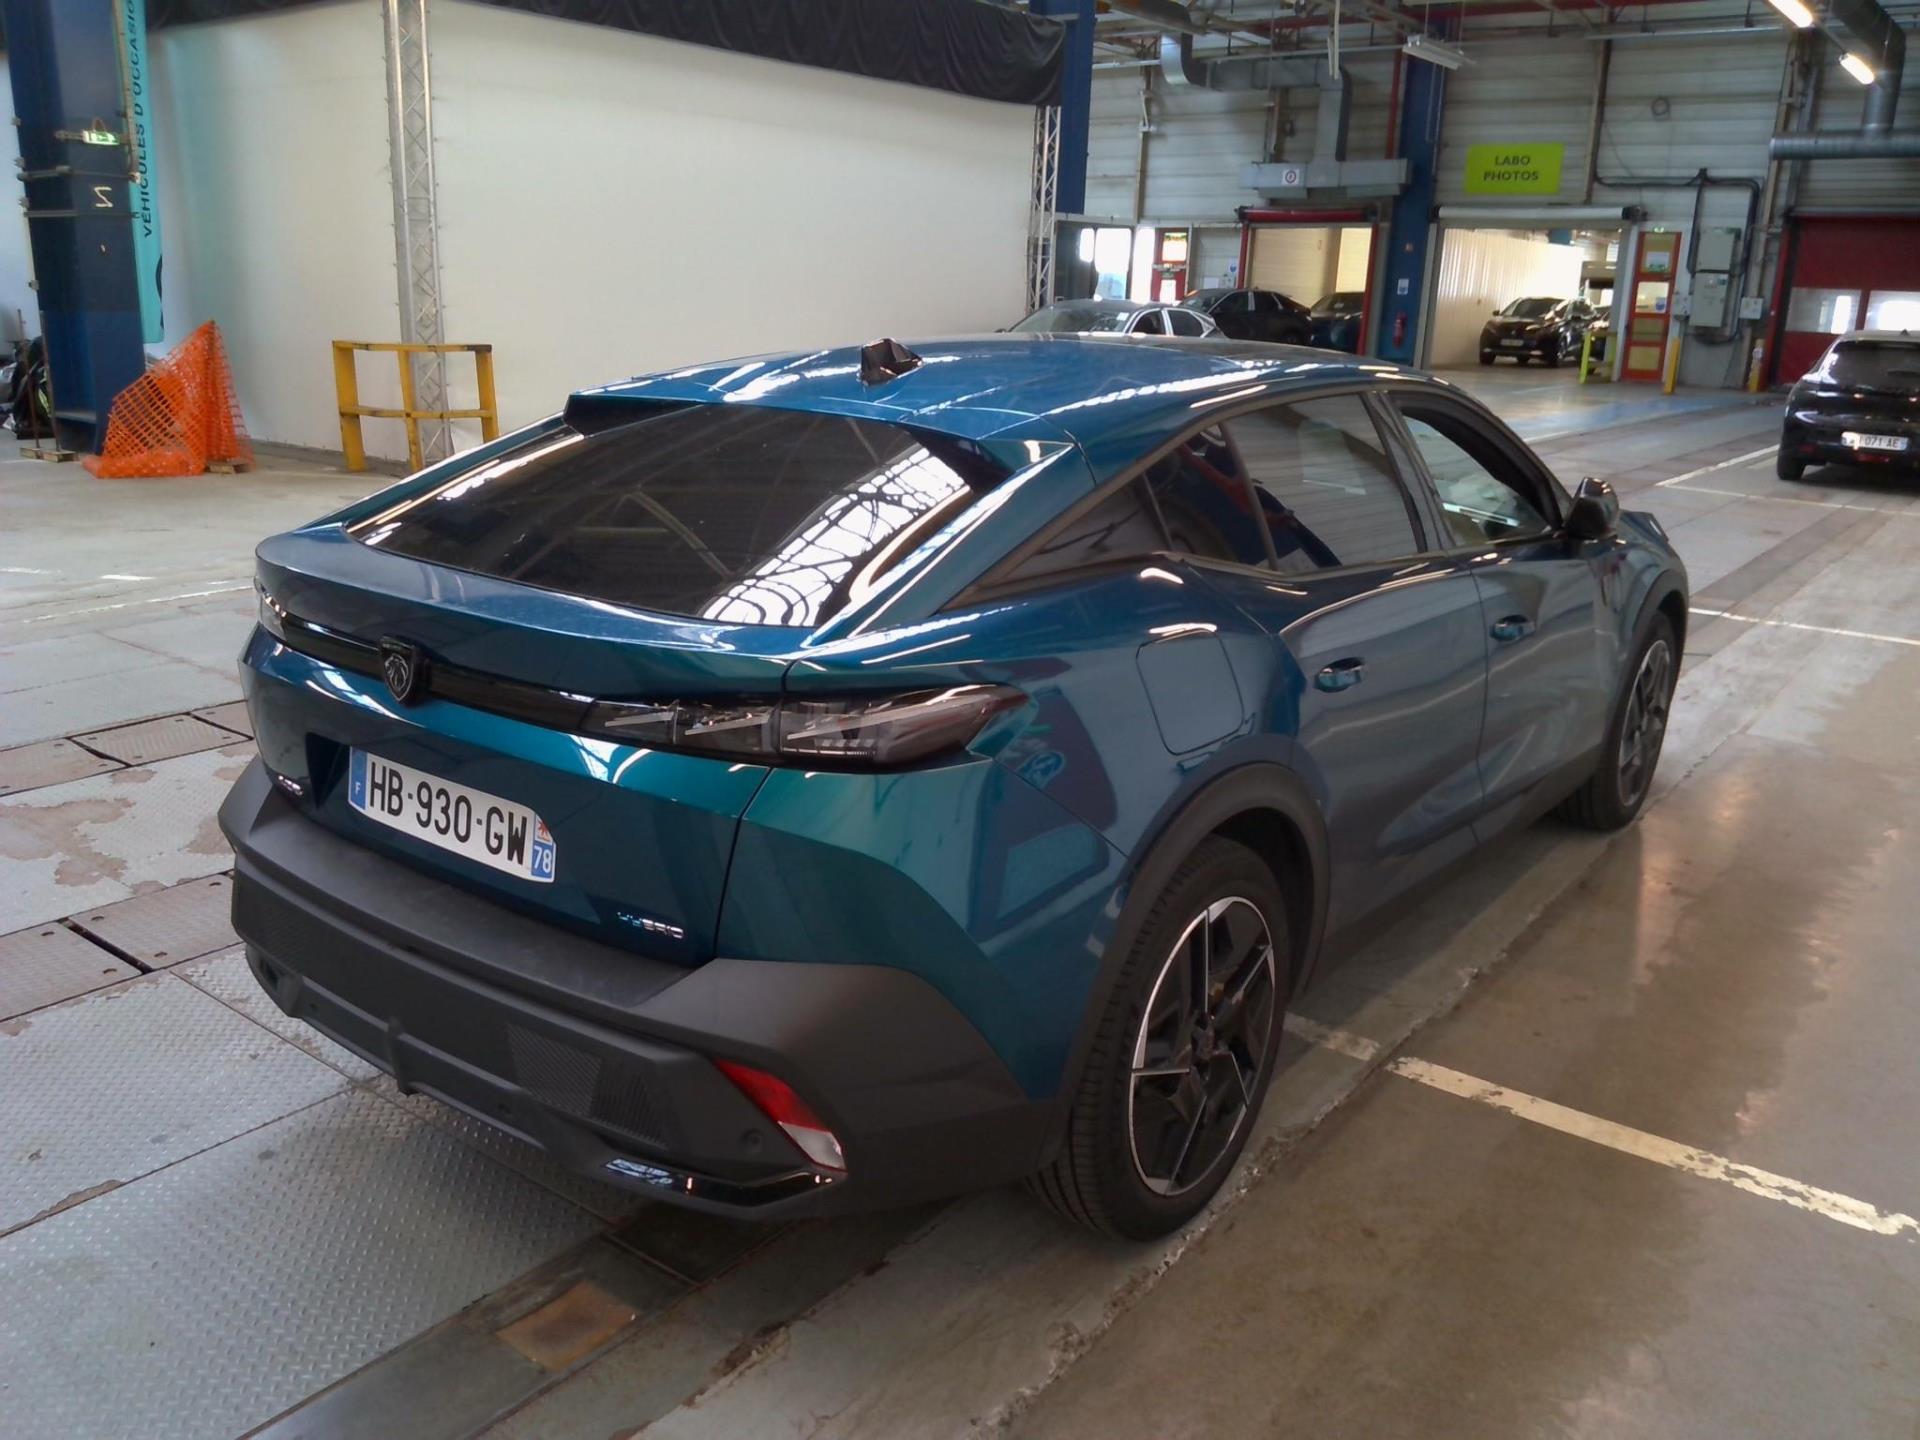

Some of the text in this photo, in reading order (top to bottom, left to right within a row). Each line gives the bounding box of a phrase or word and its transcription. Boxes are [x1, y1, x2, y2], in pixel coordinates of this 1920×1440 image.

[1494, 155, 1531, 166] LABO
[1483, 170, 1539, 181] PHOTOS
[533, 845, 553, 873] 78
